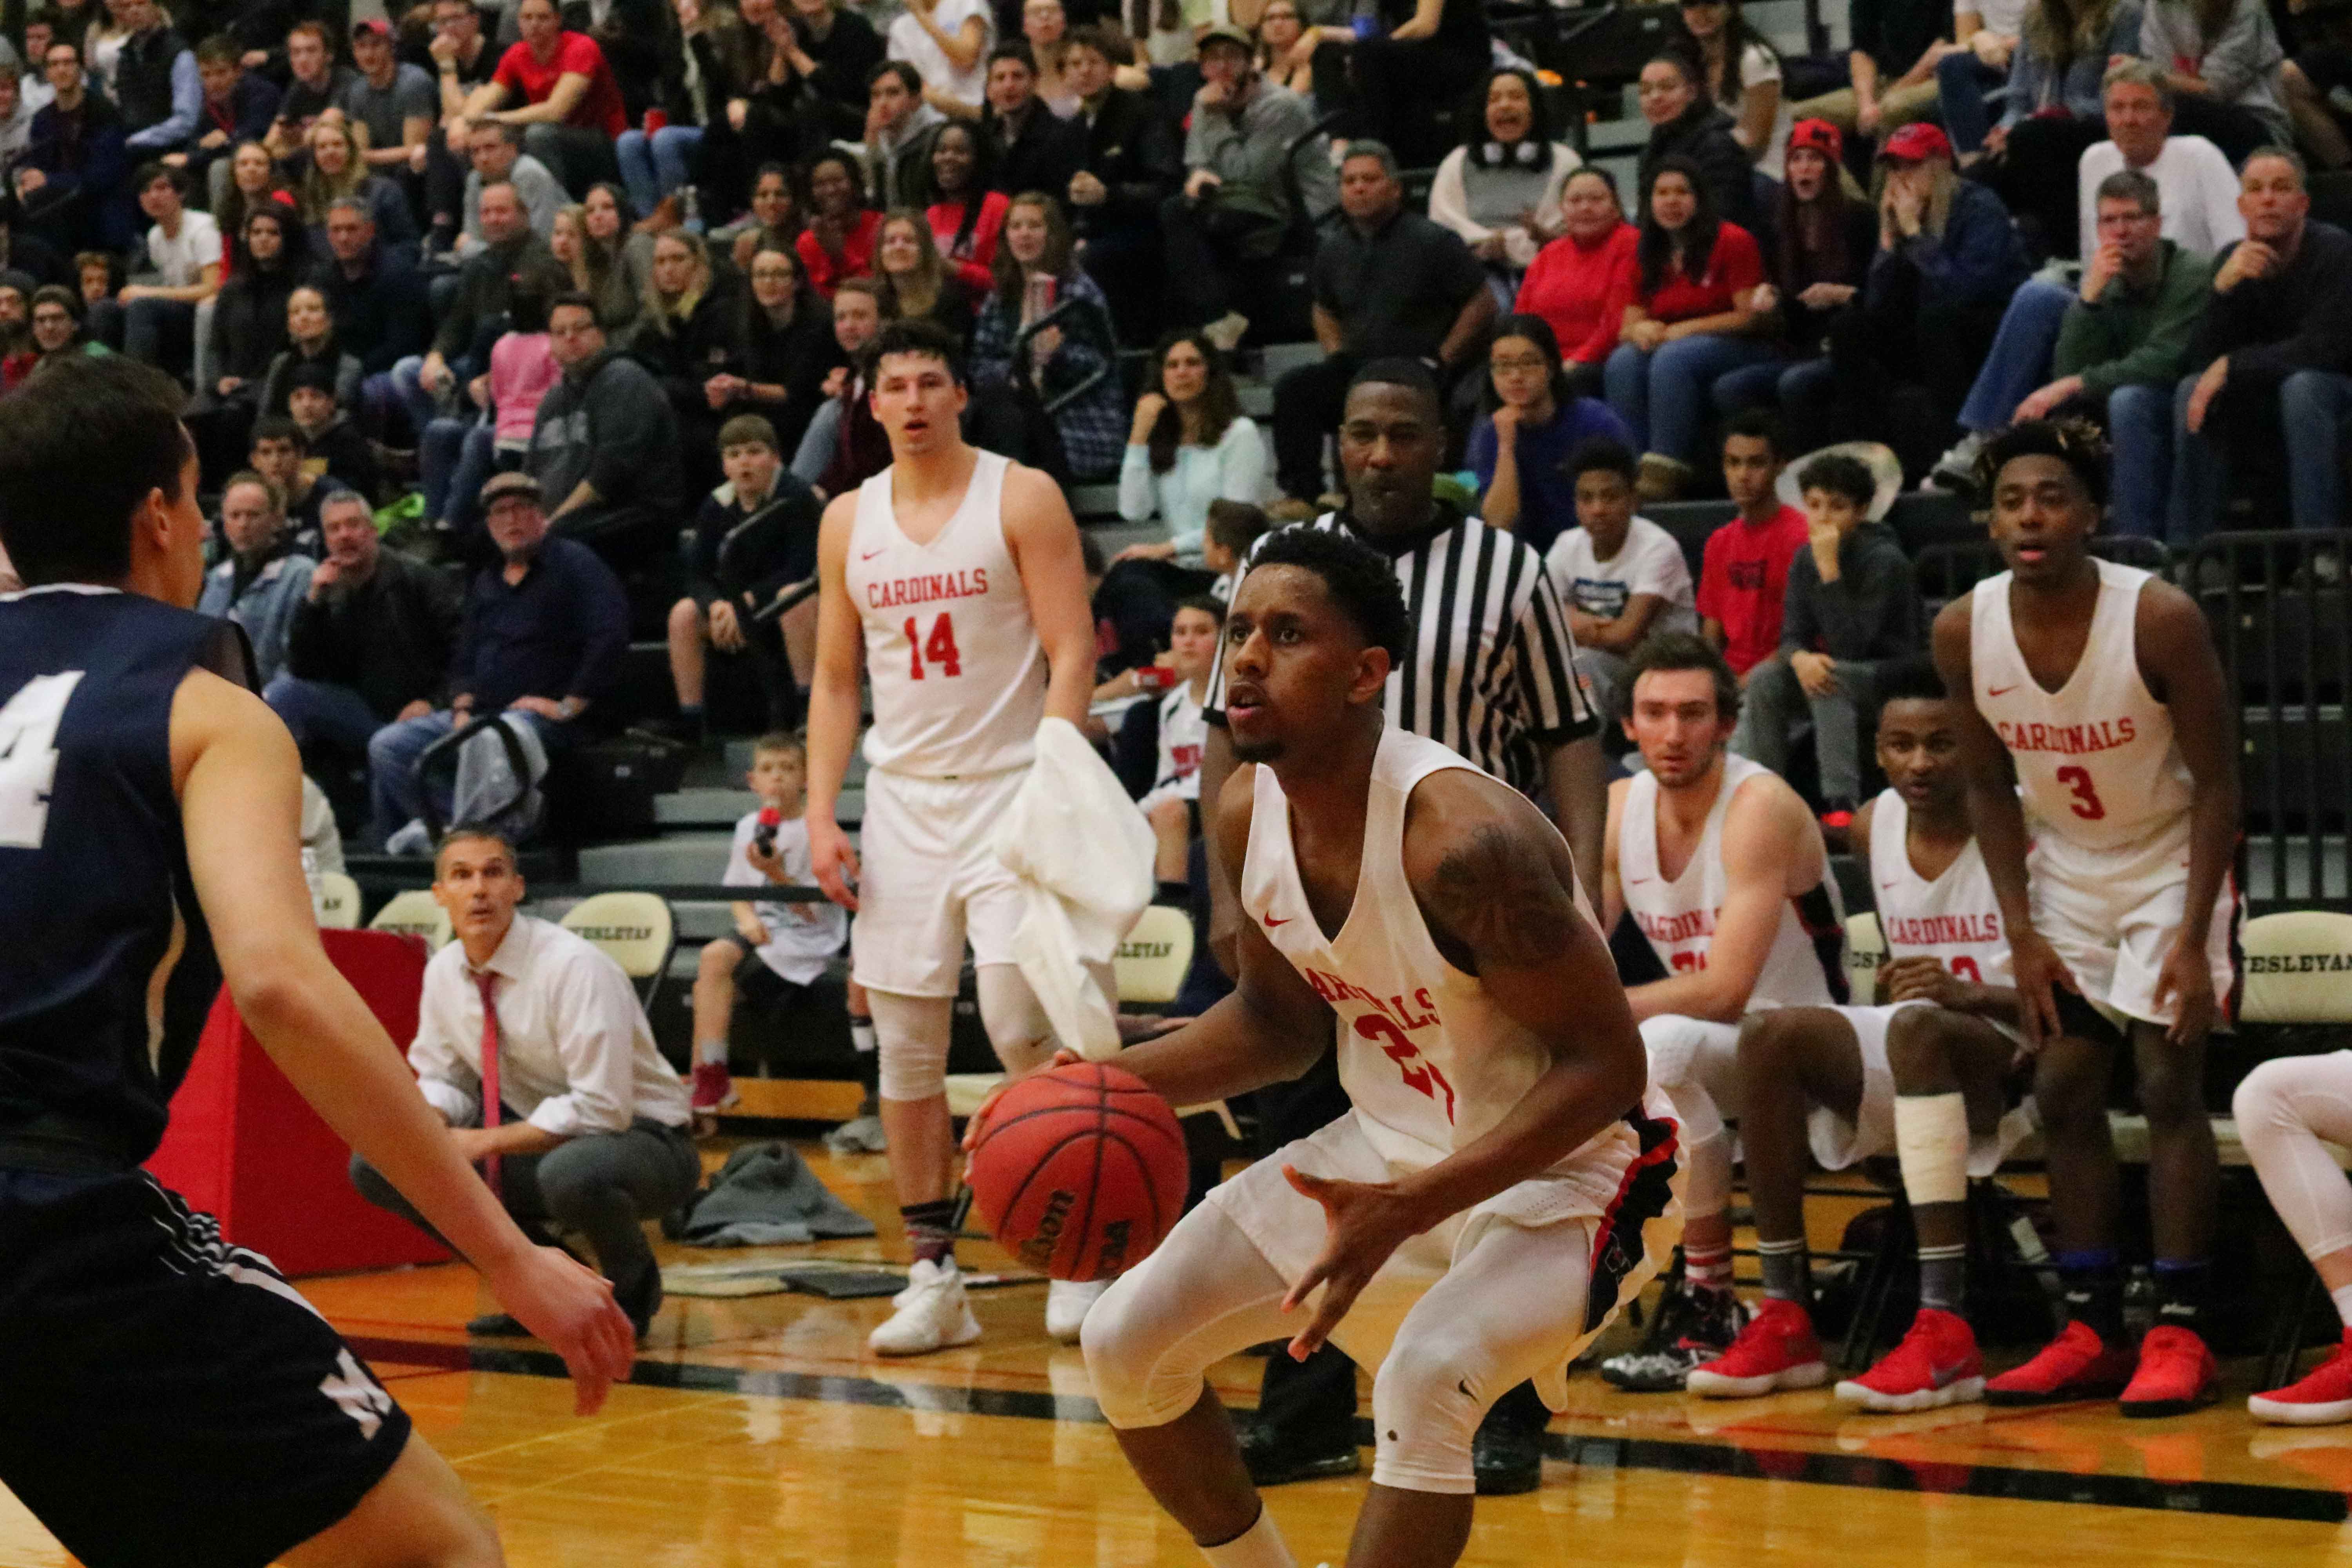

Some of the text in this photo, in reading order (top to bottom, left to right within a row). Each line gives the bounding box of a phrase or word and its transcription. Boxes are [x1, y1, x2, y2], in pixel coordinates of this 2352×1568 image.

[867, 567, 989, 609] CARDINALS
[904, 612, 962, 680] 14
[2057, 765, 2106, 820] 3
[1888, 913, 1999, 946] CARDINALS
